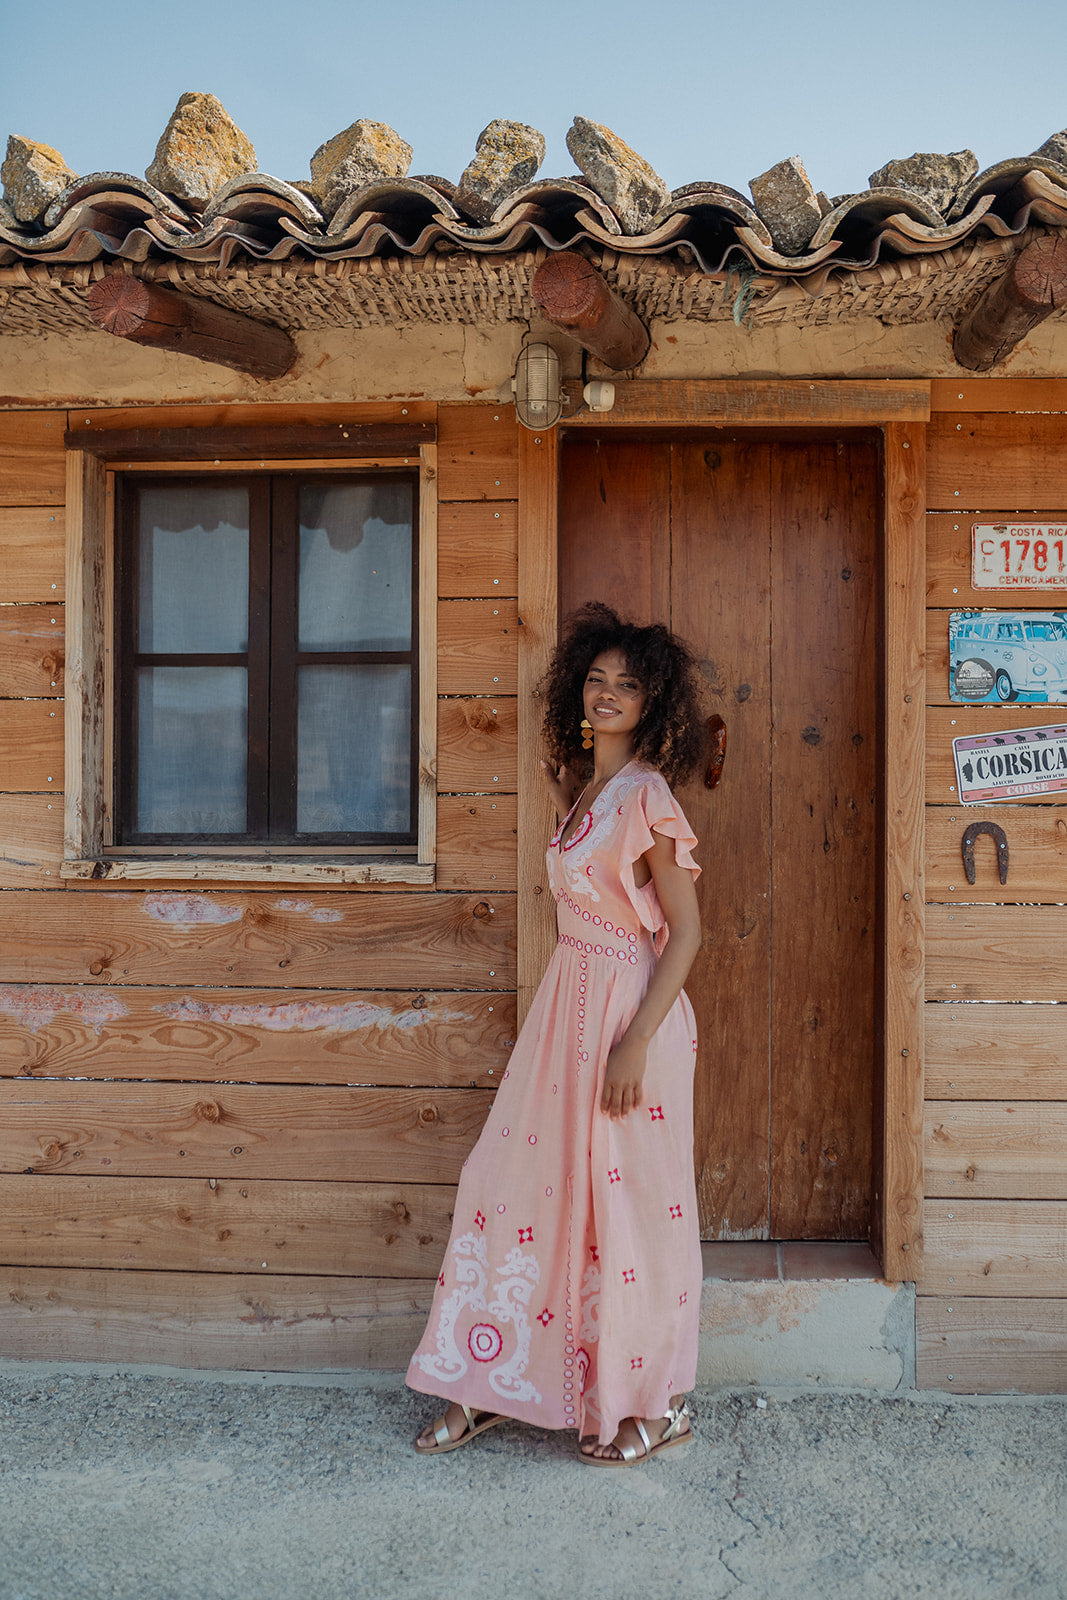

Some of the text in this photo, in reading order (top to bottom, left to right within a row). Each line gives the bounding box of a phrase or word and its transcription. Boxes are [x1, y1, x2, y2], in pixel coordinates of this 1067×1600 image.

[1010, 528, 1043, 536] COSTA
[1000, 540, 1063, 573] 1781
[976, 746, 1067, 780] CORSICA
[1006, 782, 1049, 795] CORSE
